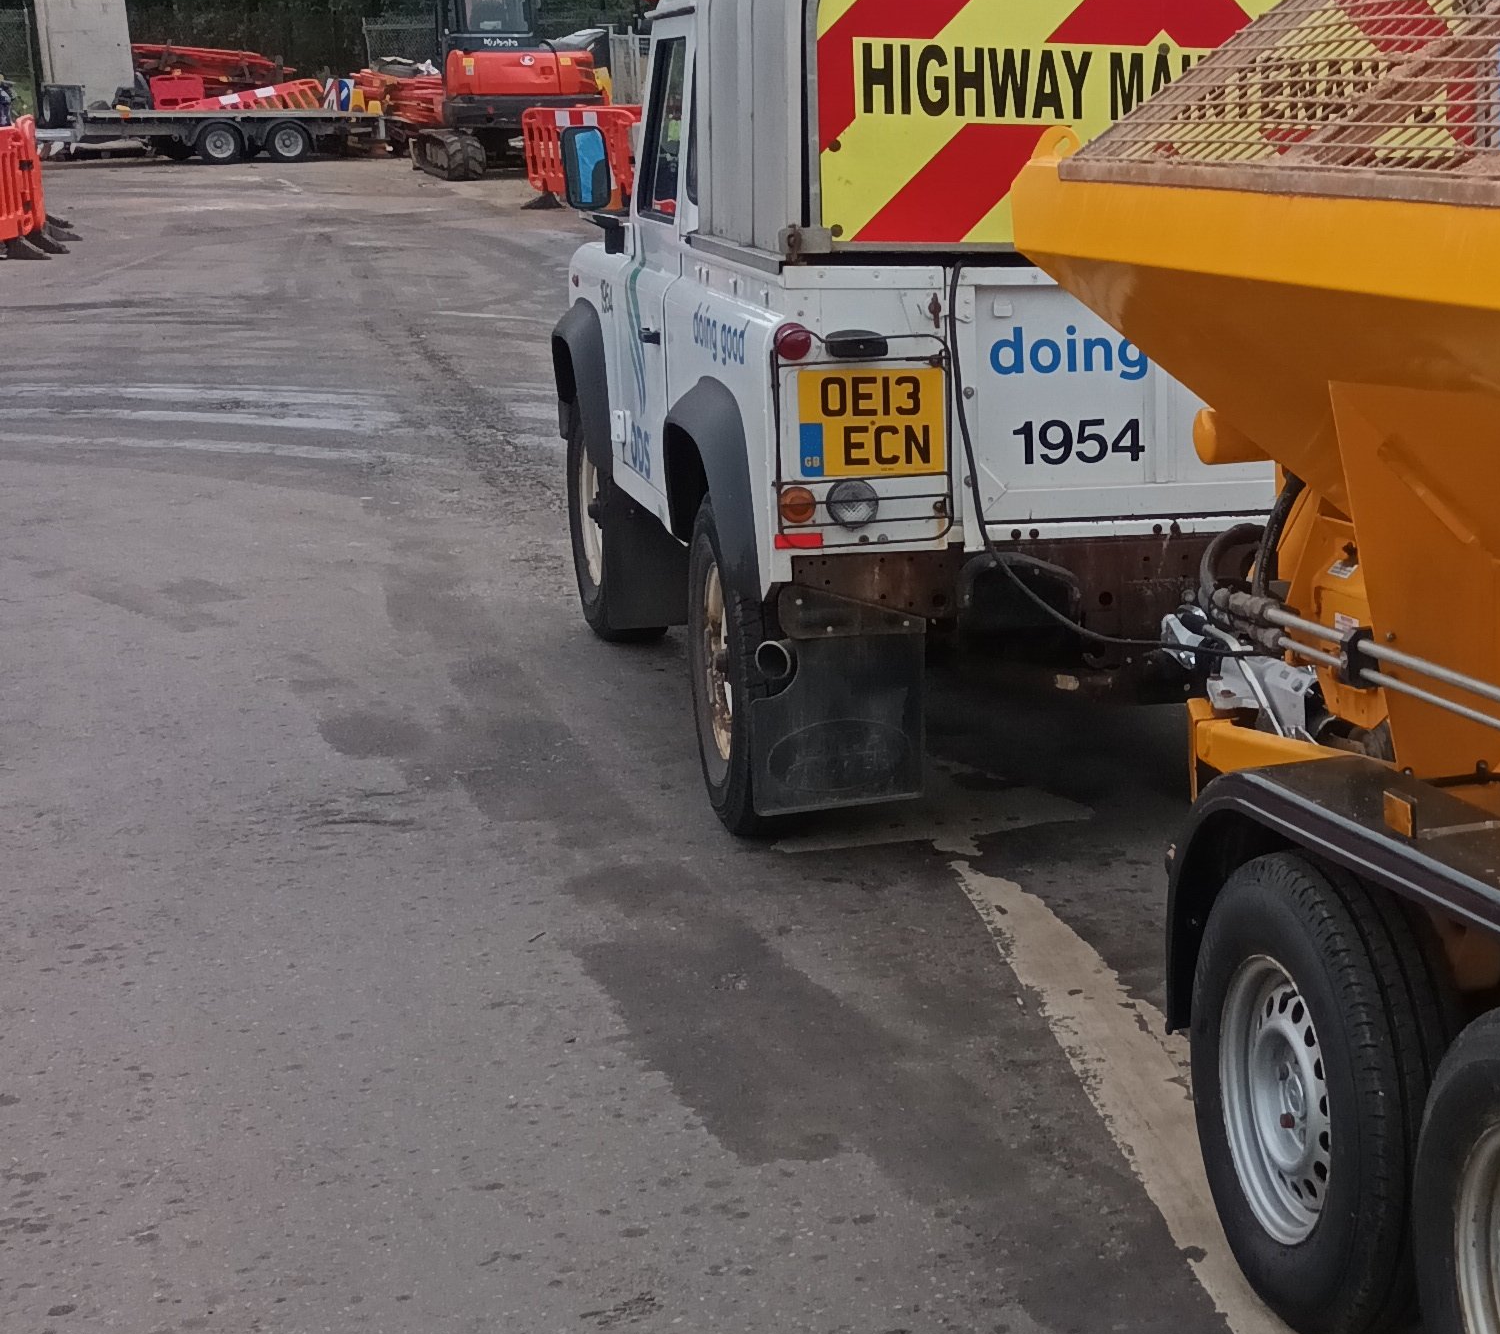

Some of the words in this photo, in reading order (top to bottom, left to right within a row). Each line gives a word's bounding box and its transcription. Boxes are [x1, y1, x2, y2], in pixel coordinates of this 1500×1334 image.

[862, 42, 1092, 120] HIGHWAY
[693, 302, 718, 362] doing
[720, 319, 751, 366] good
[989, 324, 1149, 381] doing
[820, 375, 921, 417] OE13
[630, 420, 651, 480] ODS
[804, 456, 820, 468] GB
[843, 424, 931, 466] ECN
[1012, 418, 1146, 465] 1954
